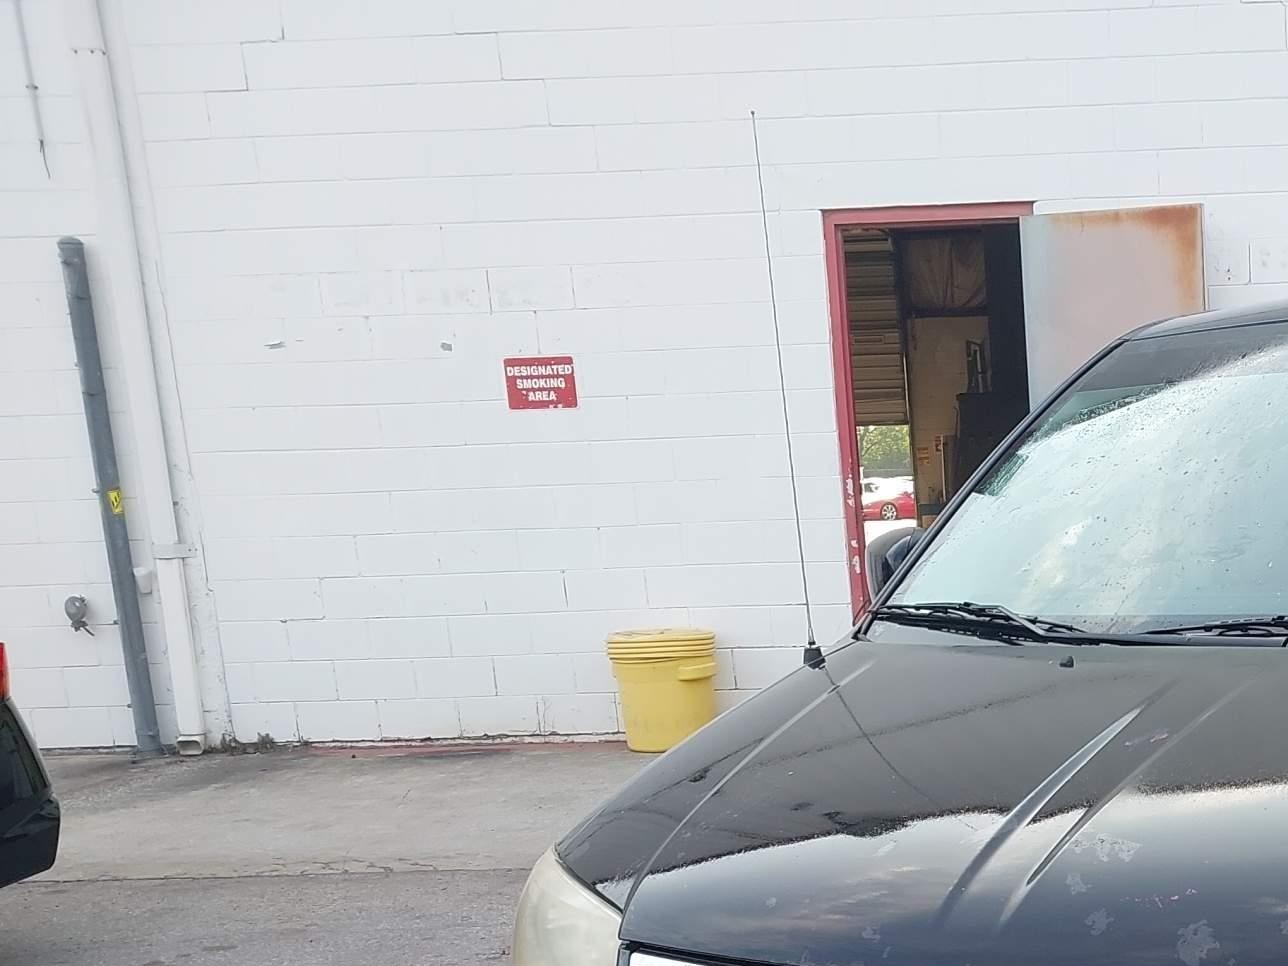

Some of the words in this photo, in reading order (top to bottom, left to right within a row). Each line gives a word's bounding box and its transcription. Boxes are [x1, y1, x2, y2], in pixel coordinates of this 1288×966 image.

[506, 364, 572, 377] DESIGNATED
[516, 377, 566, 389] SMOKING
[528, 390, 557, 401] AREA
